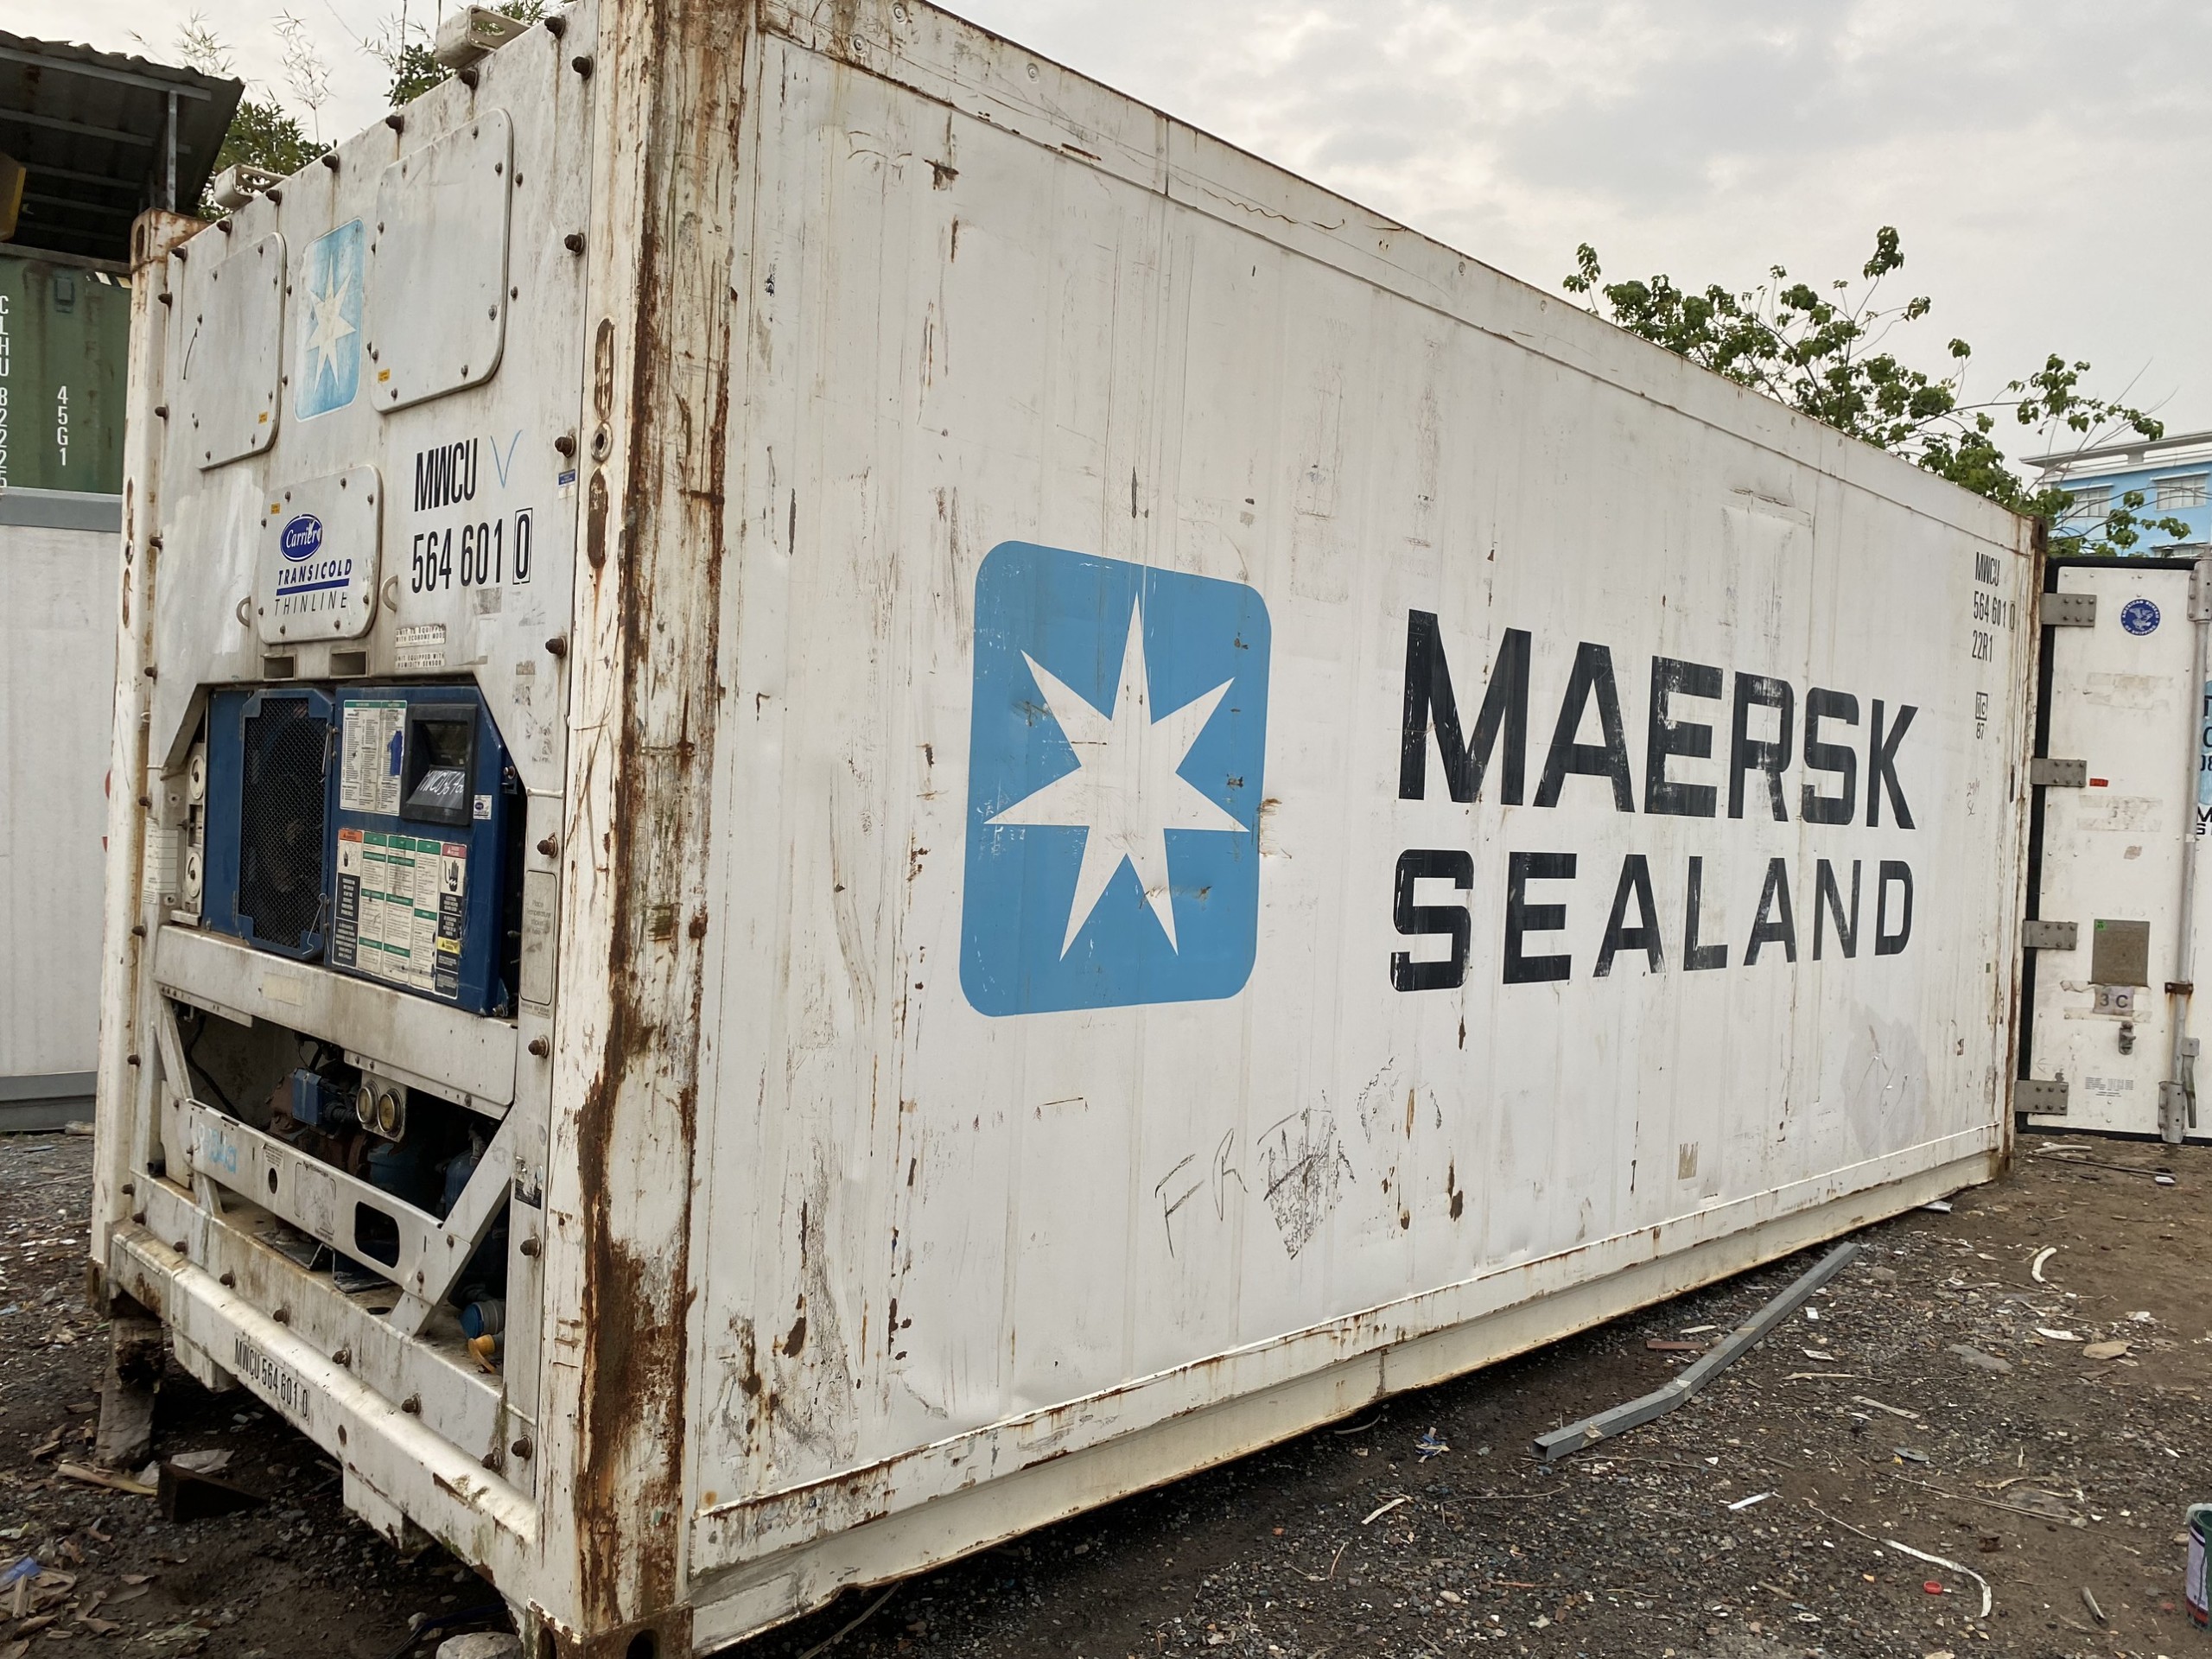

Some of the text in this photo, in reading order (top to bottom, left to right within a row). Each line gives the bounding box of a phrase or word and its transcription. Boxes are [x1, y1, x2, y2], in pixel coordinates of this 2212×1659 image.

[414, 437, 478, 512] MWCU
[286, 525, 318, 549] Carrier
[411, 513, 530, 594] 564 601 0
[278, 558, 353, 586] TRANSICOLD
[1974, 551, 2000, 587] MWCU
[275, 590, 347, 616] THINLINE
[1974, 590, 1990, 623] 564
[1992, 596, 2006, 629] 601
[1972, 630, 1993, 663] 22R1
[1398, 608, 1919, 830] MAERSK
[1976, 722, 1985, 740] 87
[1389, 849, 1915, 993] SEALAND
[234, 1338, 260, 1380] MWCU
[262, 1357, 278, 1395] 564
[281, 1372, 297, 1410] 601
